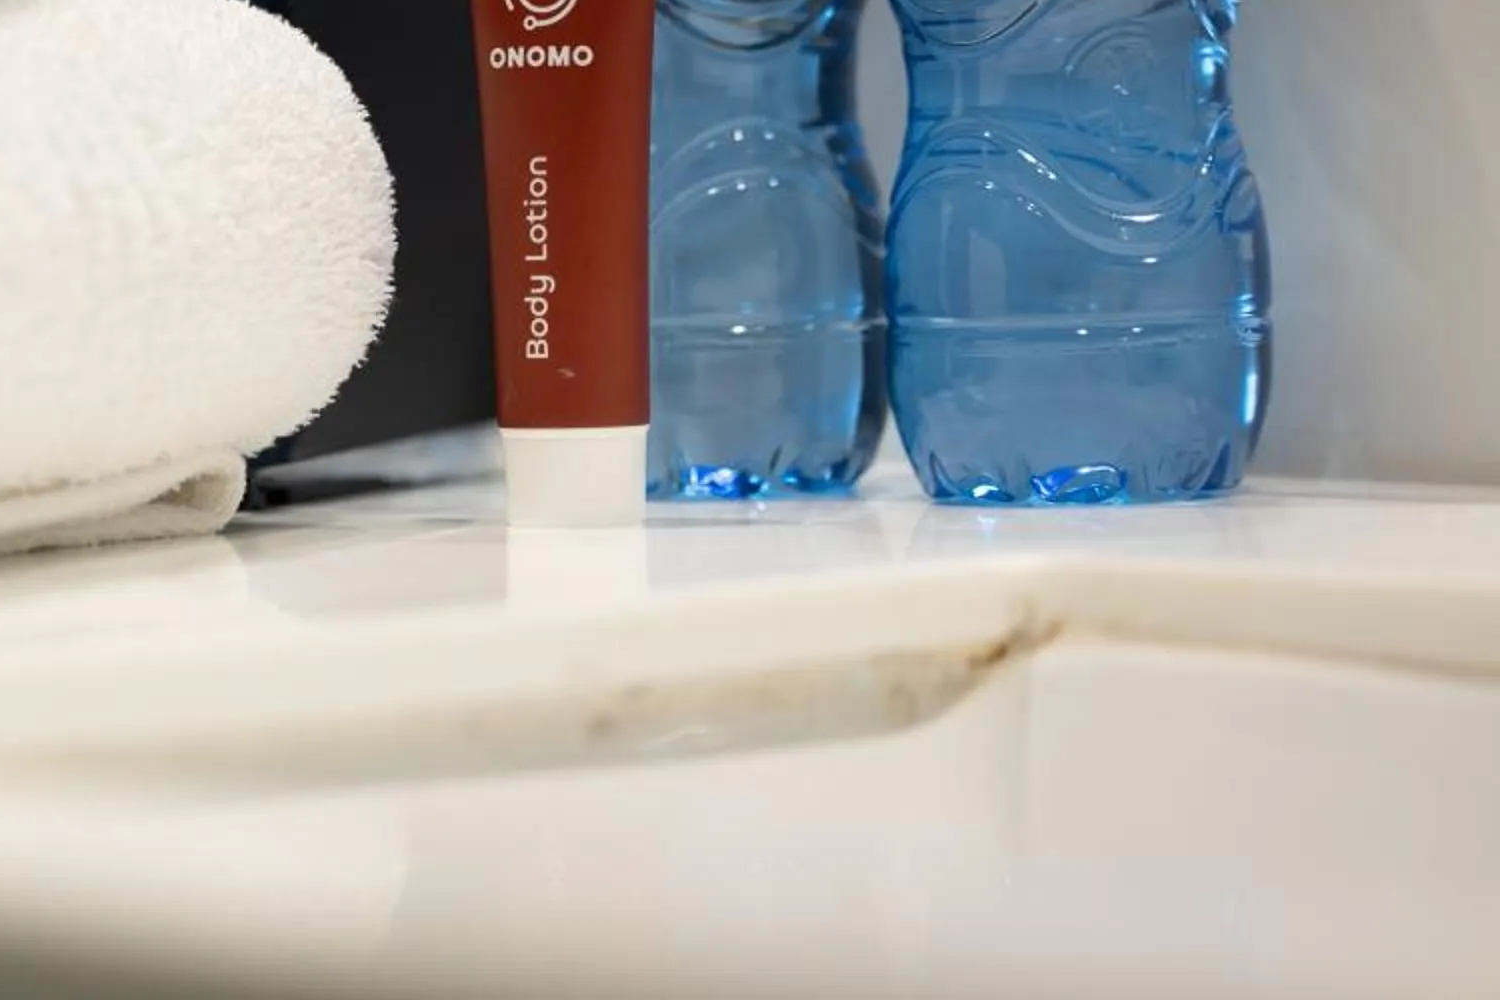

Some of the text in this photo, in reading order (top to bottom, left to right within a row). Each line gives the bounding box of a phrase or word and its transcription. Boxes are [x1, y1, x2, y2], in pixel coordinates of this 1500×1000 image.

[489, 45, 594, 69] ONOMO
[524, 155, 556, 360] Body Lotion
